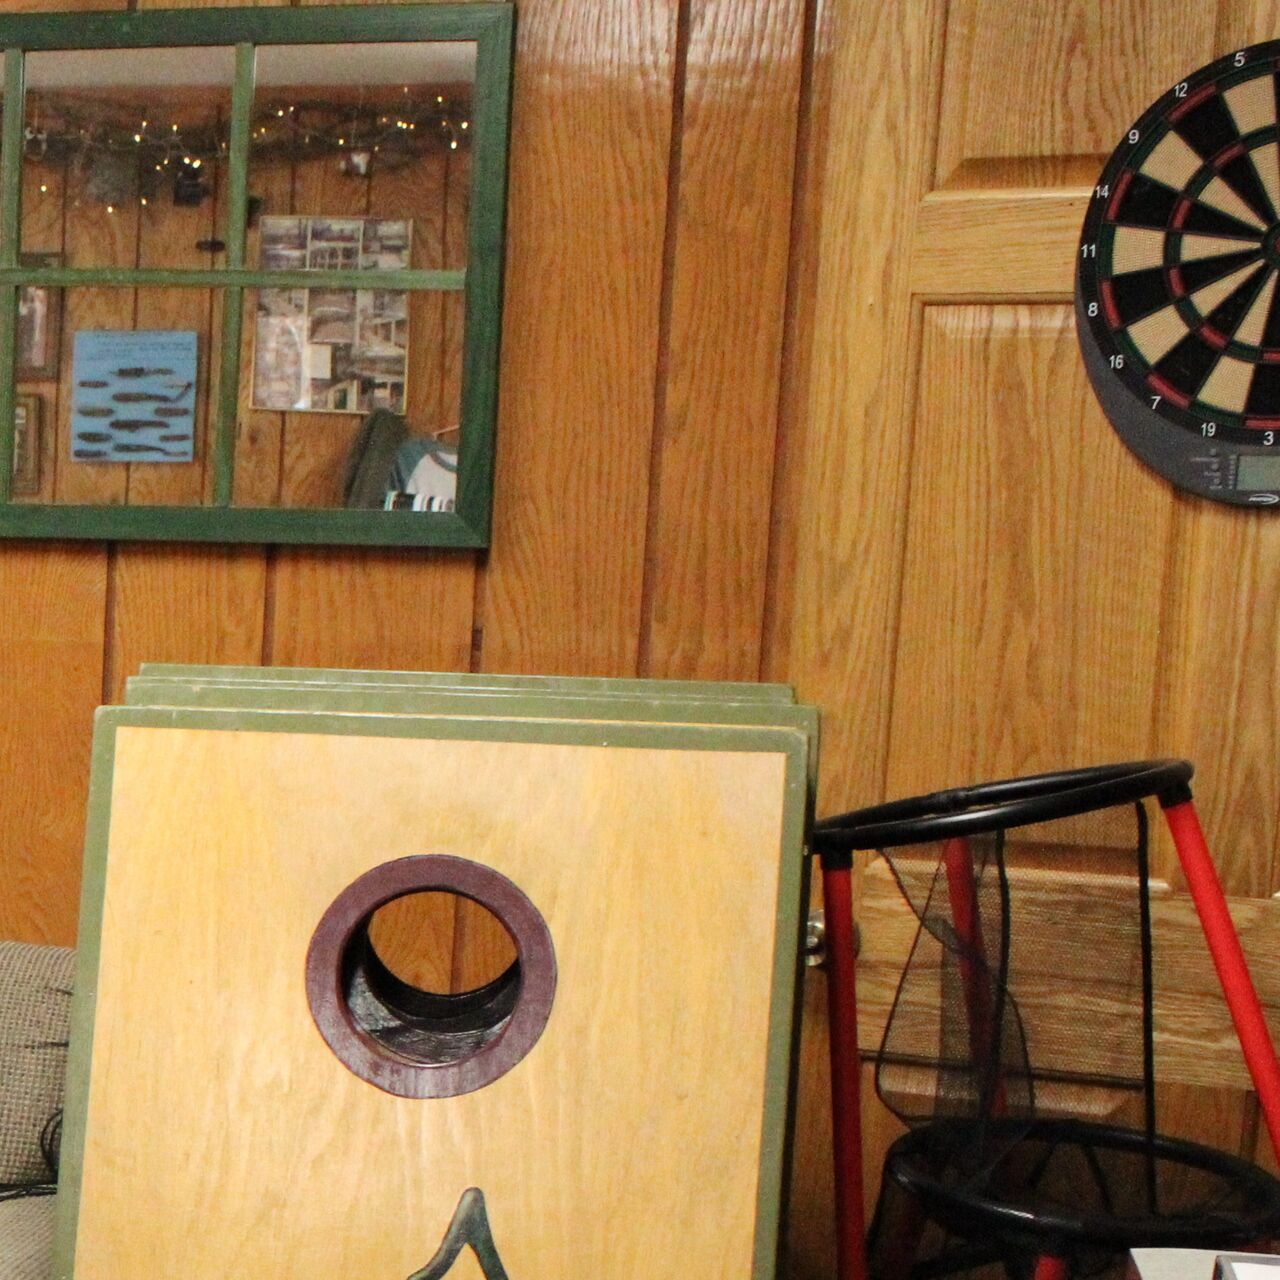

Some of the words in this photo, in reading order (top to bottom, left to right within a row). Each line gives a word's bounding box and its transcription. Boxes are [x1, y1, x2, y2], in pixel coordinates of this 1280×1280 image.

[1233, 51, 1246, 67] 5
[1174, 82, 1189, 98] 12
[1128, 129, 1140, 144] 9
[1095, 184, 1109, 199] 14
[1080, 244, 1096, 258] 11
[1087, 302, 1098, 317] 8
[1109, 354, 1124, 369] 16
[1150, 395, 1161, 410] 7
[1201, 422, 1216, 437] 19
[1263, 431, 1274, 446] 3
